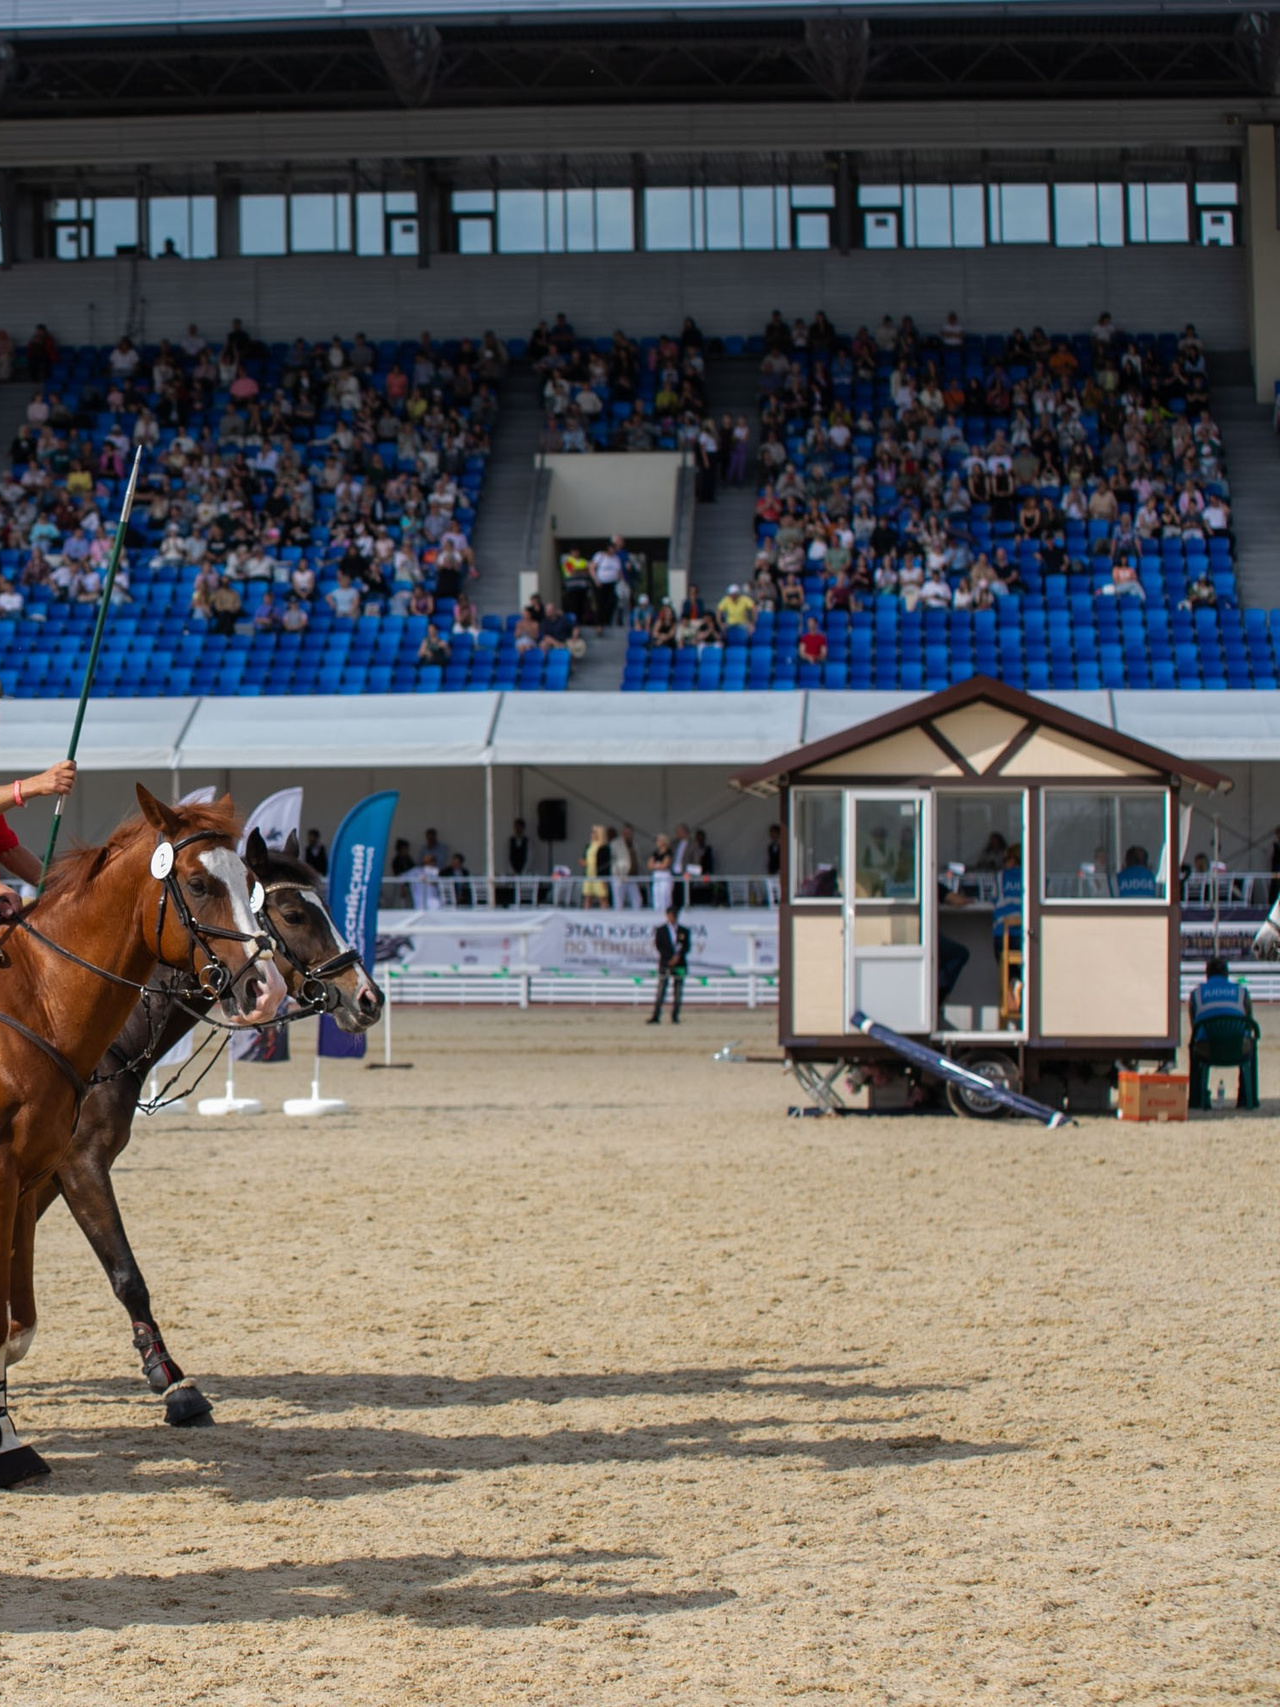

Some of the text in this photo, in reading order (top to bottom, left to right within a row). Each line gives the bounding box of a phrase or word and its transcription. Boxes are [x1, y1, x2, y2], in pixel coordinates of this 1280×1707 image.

[160, 853, 166, 867] 2
[1120, 880, 1154, 891] JUDGE
[565, 923, 604, 938] ЭТАП
[564, 940, 587, 955] ПО
